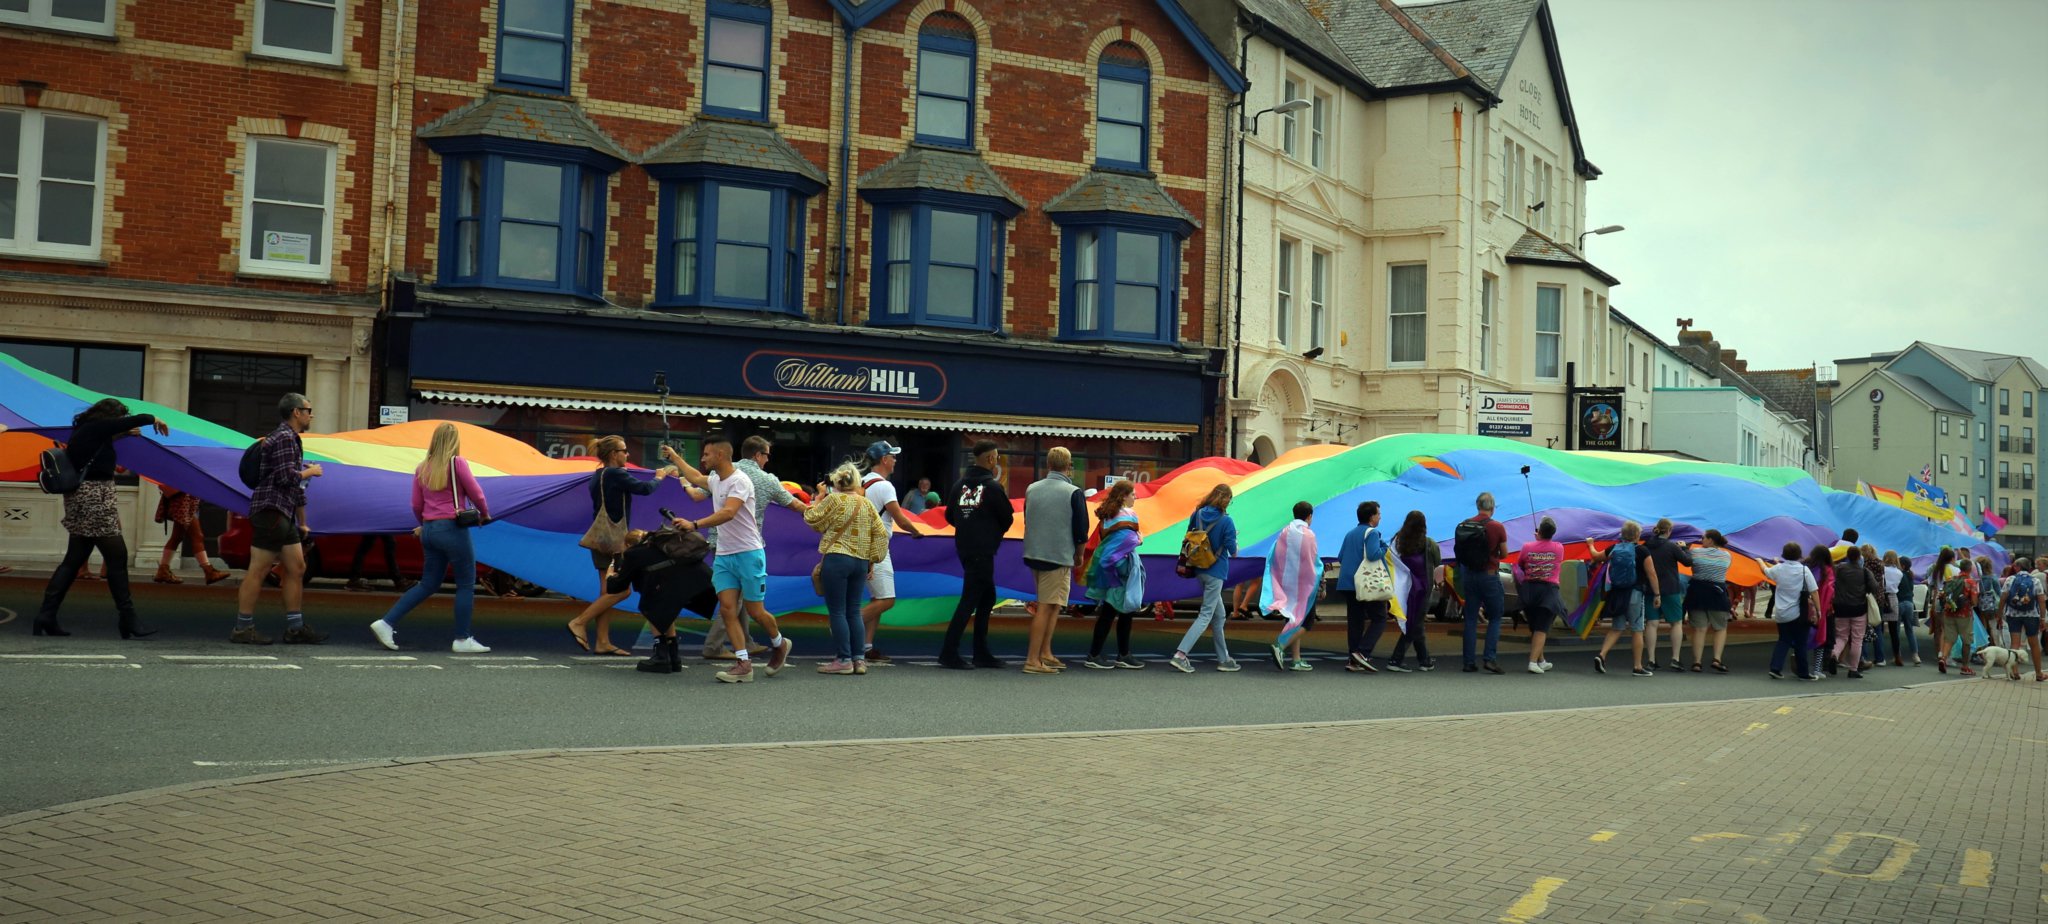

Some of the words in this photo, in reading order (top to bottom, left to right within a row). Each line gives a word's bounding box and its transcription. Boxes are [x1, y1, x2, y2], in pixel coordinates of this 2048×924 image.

[1519, 79, 1541, 106] GLOBE
[1519, 104, 1541, 130] HOTEL
[774, 358, 870, 391] William
[870, 368, 920, 394] HILL
[1872, 405, 1881, 436] Premier
[546, 443, 587, 459] £10
[1872, 437, 1881, 450] Inn
